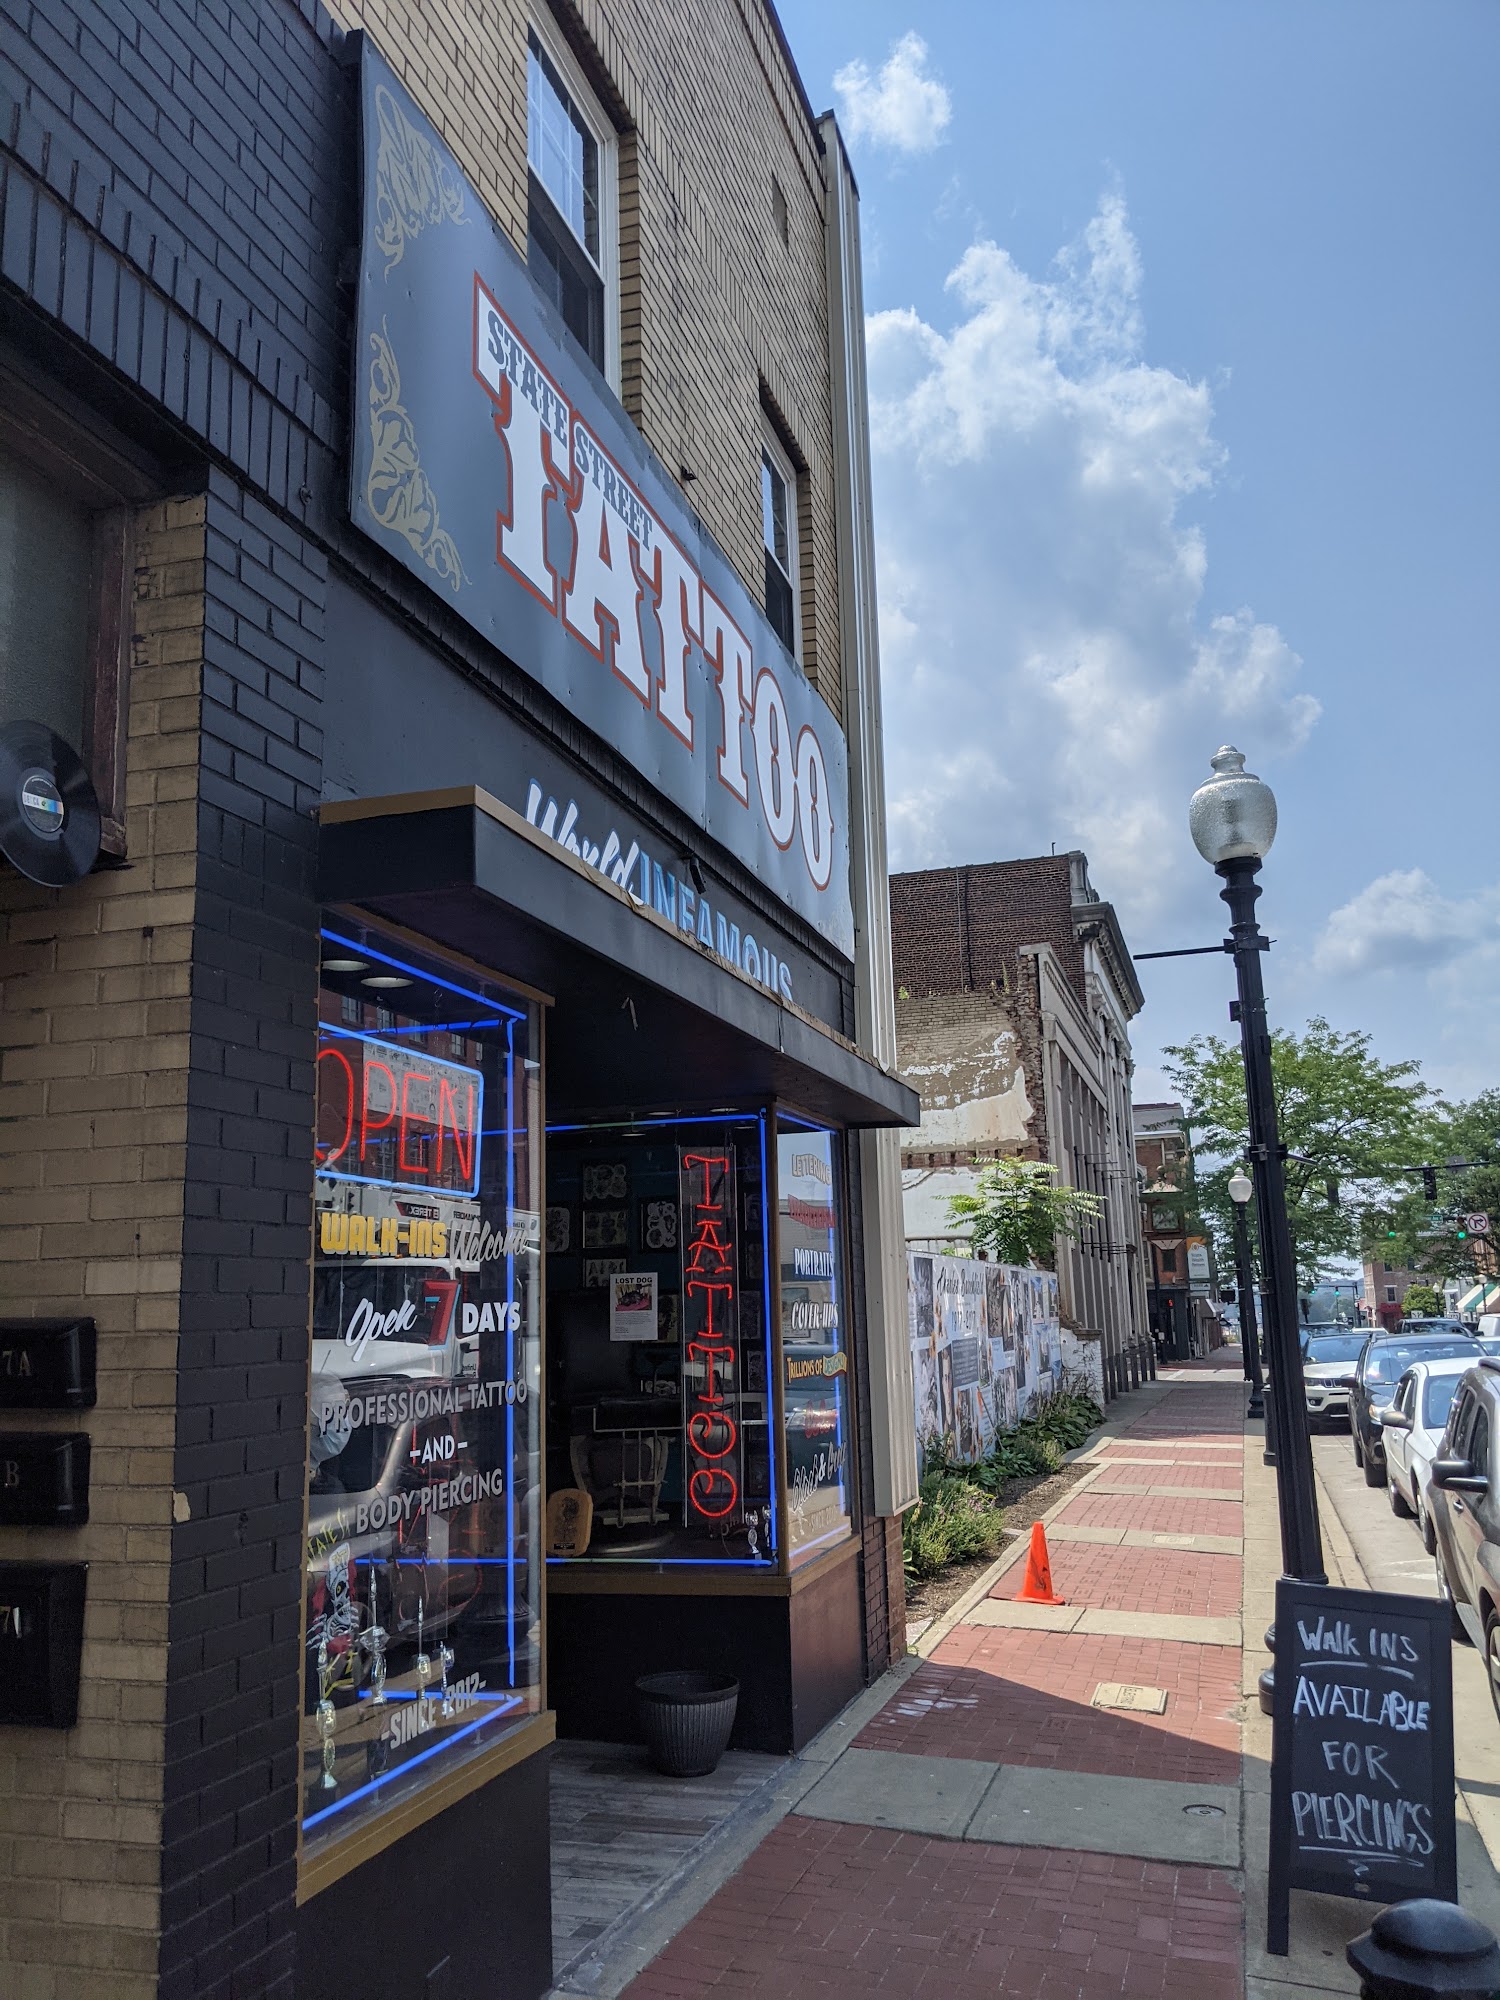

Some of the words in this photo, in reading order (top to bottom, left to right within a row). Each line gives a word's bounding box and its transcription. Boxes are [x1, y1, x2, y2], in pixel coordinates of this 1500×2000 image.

[487, 309, 568, 449] STATE
[575, 423, 653, 547] STREET
[474, 271, 833, 890] TATTOO
[317, 1048, 474, 1180] OPEN
[791, 1153, 833, 1186] LETTERING
[321, 1212, 447, 1258] WALK-INS
[450, 1219, 529, 1265] Welcome
[794, 1247, 834, 1278] PORTRAITS
[636, 1276, 653, 1284] DOG
[345, 1297, 418, 1363] Open
[423, 1279, 461, 1351] 7
[462, 1301, 521, 1335] DAYS
[684, 1153, 737, 1517] TATTOO
[791, 1300, 839, 1330] COVER-UPS
[786, 1357, 814, 1384] TRILLIONS
[814, 1358, 823, 1377] OF
[320, 1385, 463, 1435] PROFESSIONAL
[467, 1378, 528, 1410] TATTOO
[818, 1453, 826, 1481] &
[356, 1494, 416, 1534] BODY
[420, 1468, 503, 1516] PIERCING
[1370, 1628, 1419, 1662] INS
[1293, 1675, 1431, 1731] AVAILABLE
[1322, 1741, 1399, 1789] FOR
[1292, 1791, 1434, 1855] PIERCINGS
